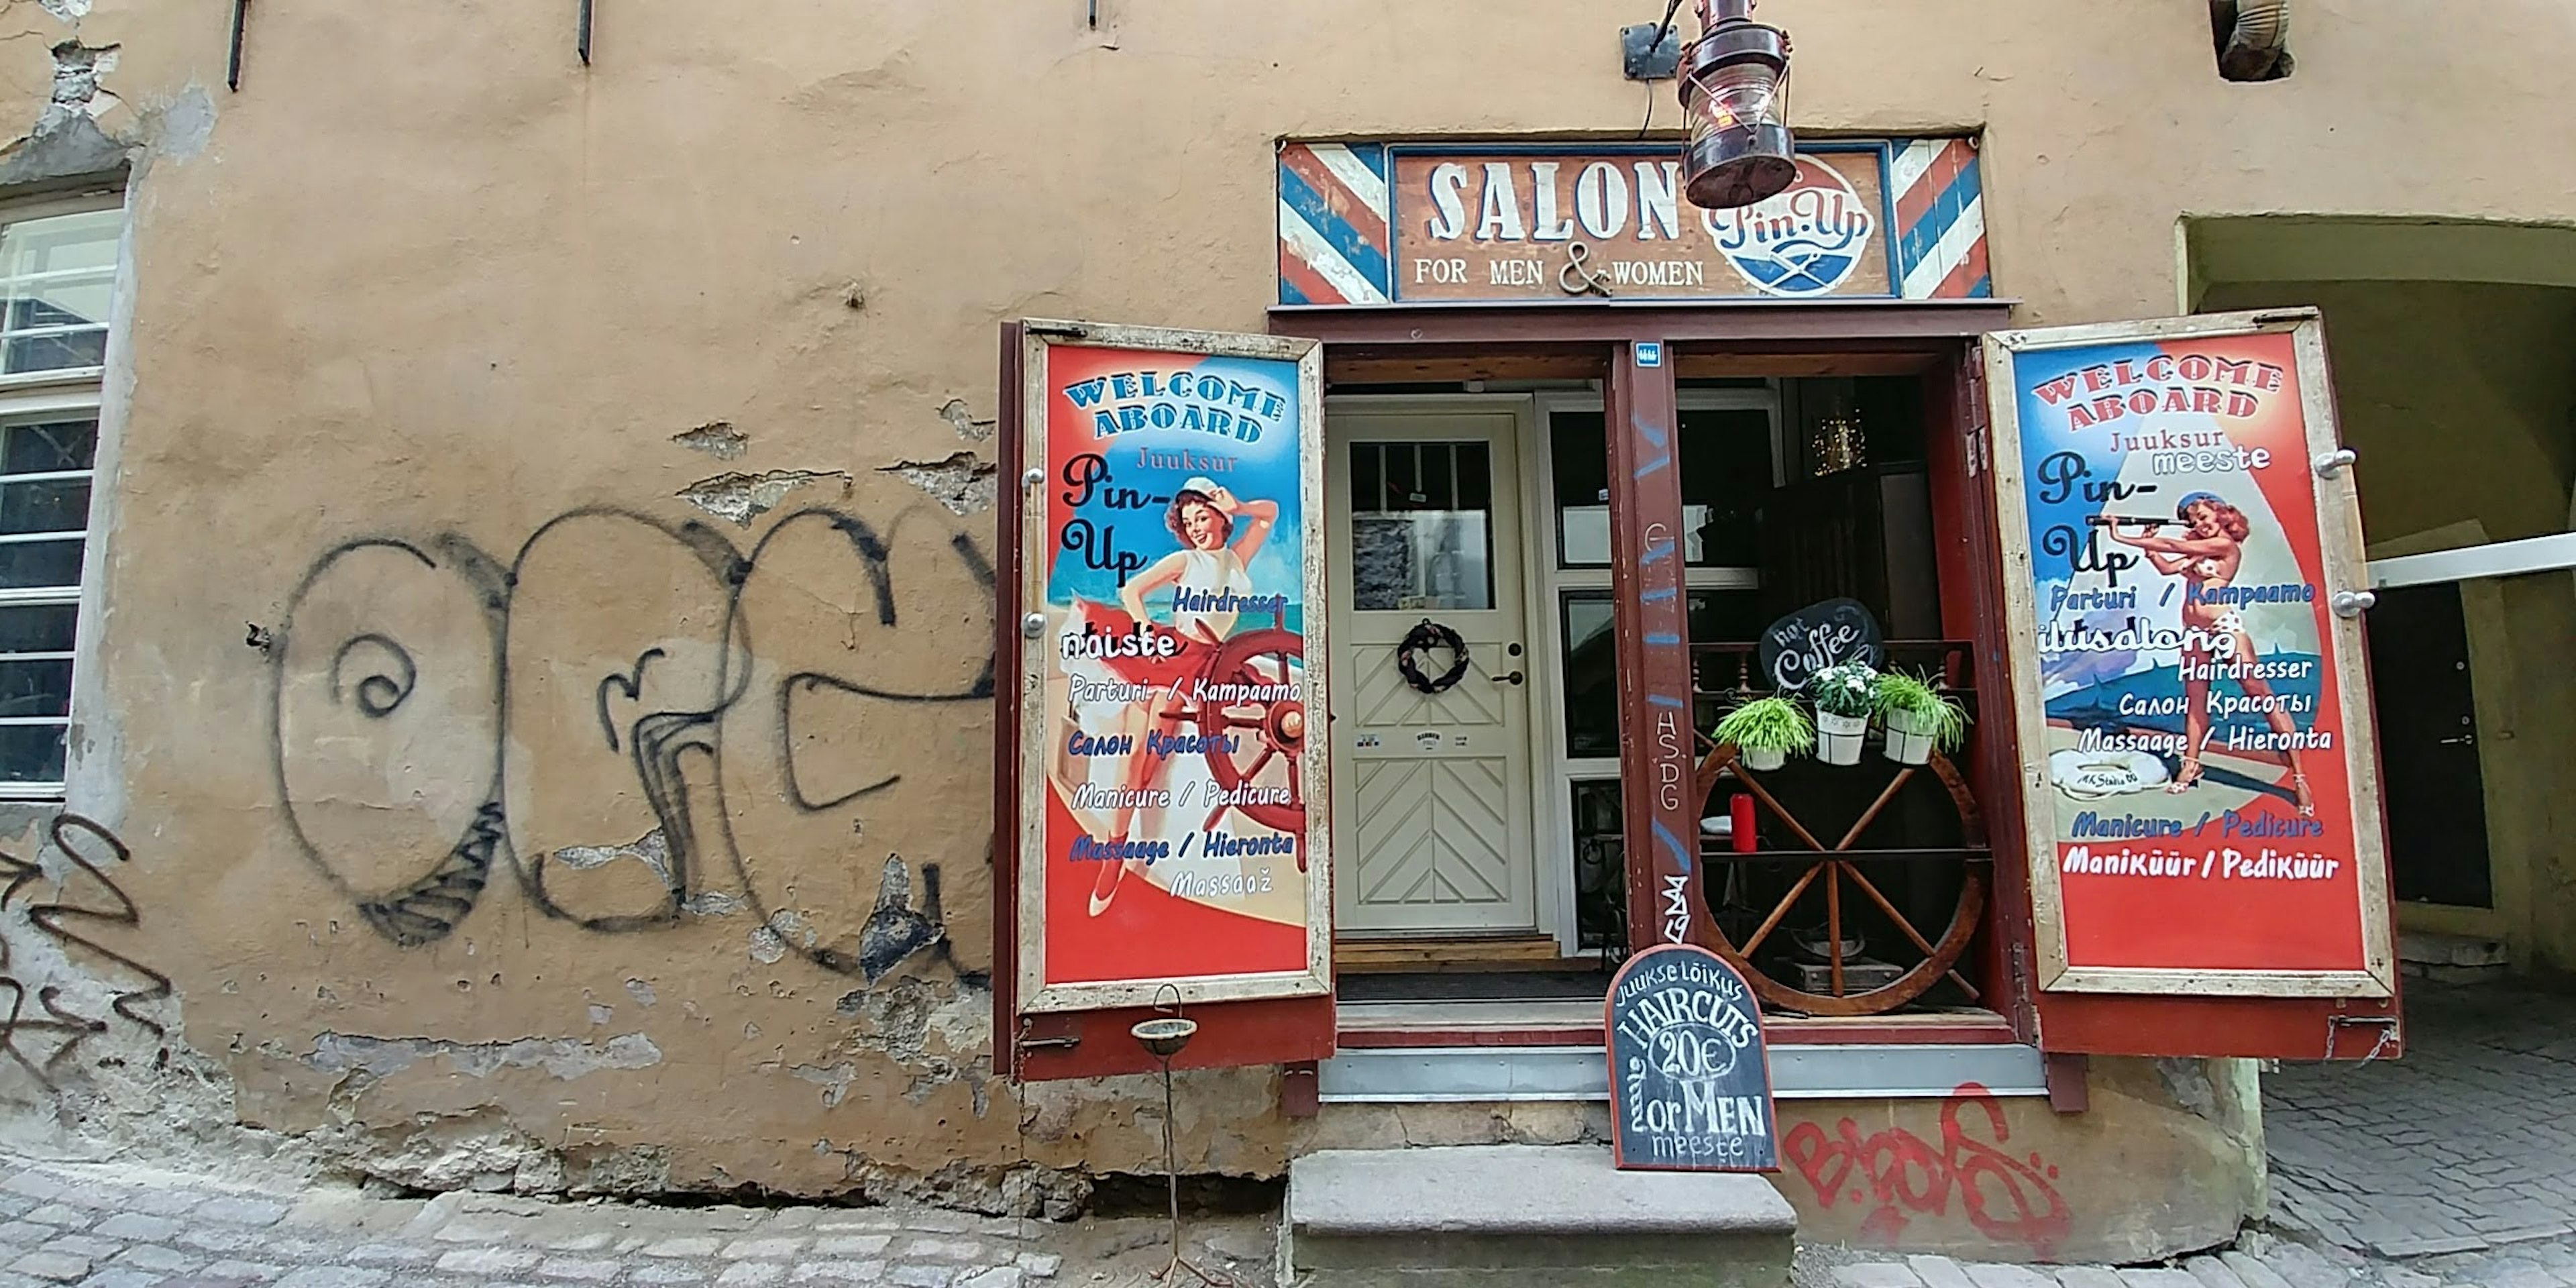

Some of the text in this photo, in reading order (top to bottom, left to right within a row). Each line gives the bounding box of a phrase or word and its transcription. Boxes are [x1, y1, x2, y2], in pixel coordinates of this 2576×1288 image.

[1426, 162, 1680, 242] SALON
[1414, 258, 1467, 284] FOR
[1490, 260, 1543, 285] MEN
[1611, 261, 1703, 286] WOMEN
[1063, 371, 1287, 422] WELCOME
[2033, 354, 2283, 407] WELCOME
[1094, 403, 1264, 443] ABOARD
[2067, 387, 2259, 431] ABOARD
[2110, 429, 2224, 451] Juuksur
[1136, 447, 1238, 472] Juuksur
[2153, 446, 2271, 475] meeste
[1061, 519, 1147, 588] Up
[2043, 525, 2139, 587] Up
[1172, 586, 1289, 613] Hairdresser
[2051, 584, 2137, 611] Parturi
[2186, 581, 2315, 610] Kampaamo
[1061, 626, 1175, 659] naiste
[1774, 623, 1860, 690] Coffee
[2178, 654, 2313, 682] Hairdresser
[1068, 675, 1149, 702] Parturi
[1192, 680, 1301, 706] Kampaamo
[2119, 690, 2311, 719] Салон Красоты
[1068, 730, 1239, 760] Салон Красоты
[2078, 727, 2188, 757] Massaage
[2228, 722, 2332, 751] Hieronta
[1072, 783, 1171, 810] Manicure
[1204, 781, 1291, 806] Pedicure
[2071, 811, 2182, 838] Manicure
[2222, 810, 2323, 838] Pedicure
[1069, 835, 1169, 865] Massaage
[1203, 832, 1294, 857] Hieronta
[1169, 867, 1273, 898] Massaaž
[1616, 987, 1758, 1050] HAIRCUTS
[1659, 1029, 1727, 1076] 20€
[1679, 1081, 1766, 1136] MEN
[1652, 1135, 1743, 1157] meeste
